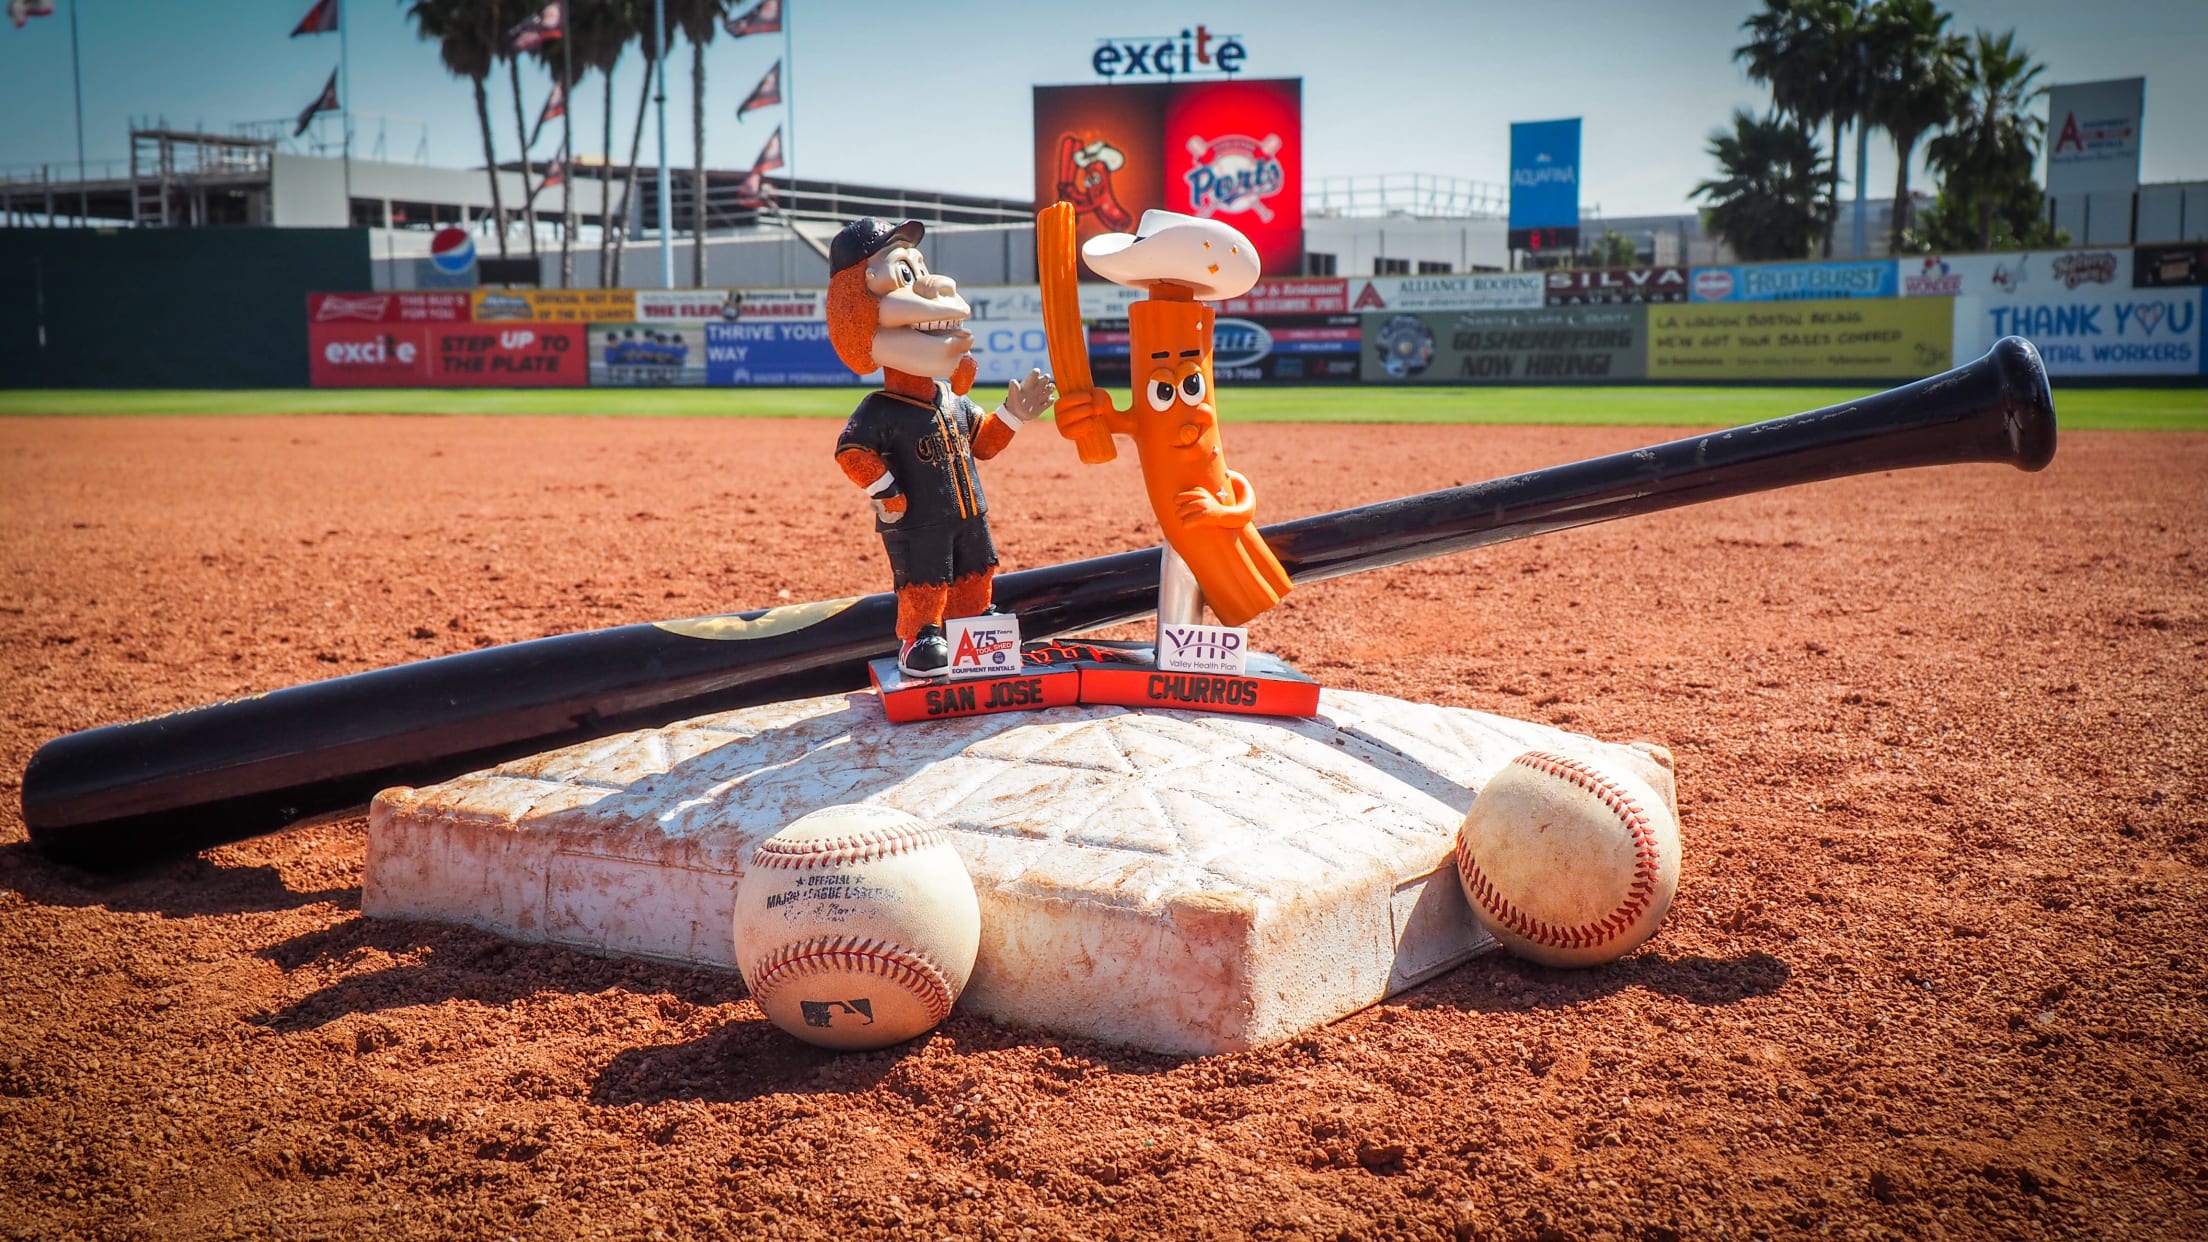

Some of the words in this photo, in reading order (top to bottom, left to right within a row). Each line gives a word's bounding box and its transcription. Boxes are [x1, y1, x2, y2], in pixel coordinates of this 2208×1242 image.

[1092, 25, 1246, 76] excite
[1187, 158, 1280, 206] Ports
[1400, 279, 1466, 293] ALLIANCE
[1473, 277, 1540, 291] ROOFING
[1549, 269, 1684, 289] SILVA
[643, 304, 676, 317] THE
[681, 304, 723, 317] FLEA
[741, 304, 816, 317] MARKET
[1988, 302, 2101, 338] THANK
[440, 336, 496, 353] STEP
[500, 330, 535, 350] UP
[540, 336, 570, 352] TO
[708, 325, 776, 342] THRIVE
[325, 333, 416, 364] excite
[708, 345, 749, 363] WAY
[2091, 342, 2192, 364] WORKERS
[442, 357, 486, 373] THE
[490, 356, 561, 373] PLATE
[1460, 355, 1514, 377] NOW
[1169, 659, 1192, 669] Valley
[1193, 661, 1219, 669] Health
[1220, 661, 1237, 671] Plan
[926, 685, 976, 715] SAN
[984, 678, 1044, 709] JOSE
[1147, 674, 1258, 707] CHURROS
[808, 875, 851, 887] OFFICIAL
